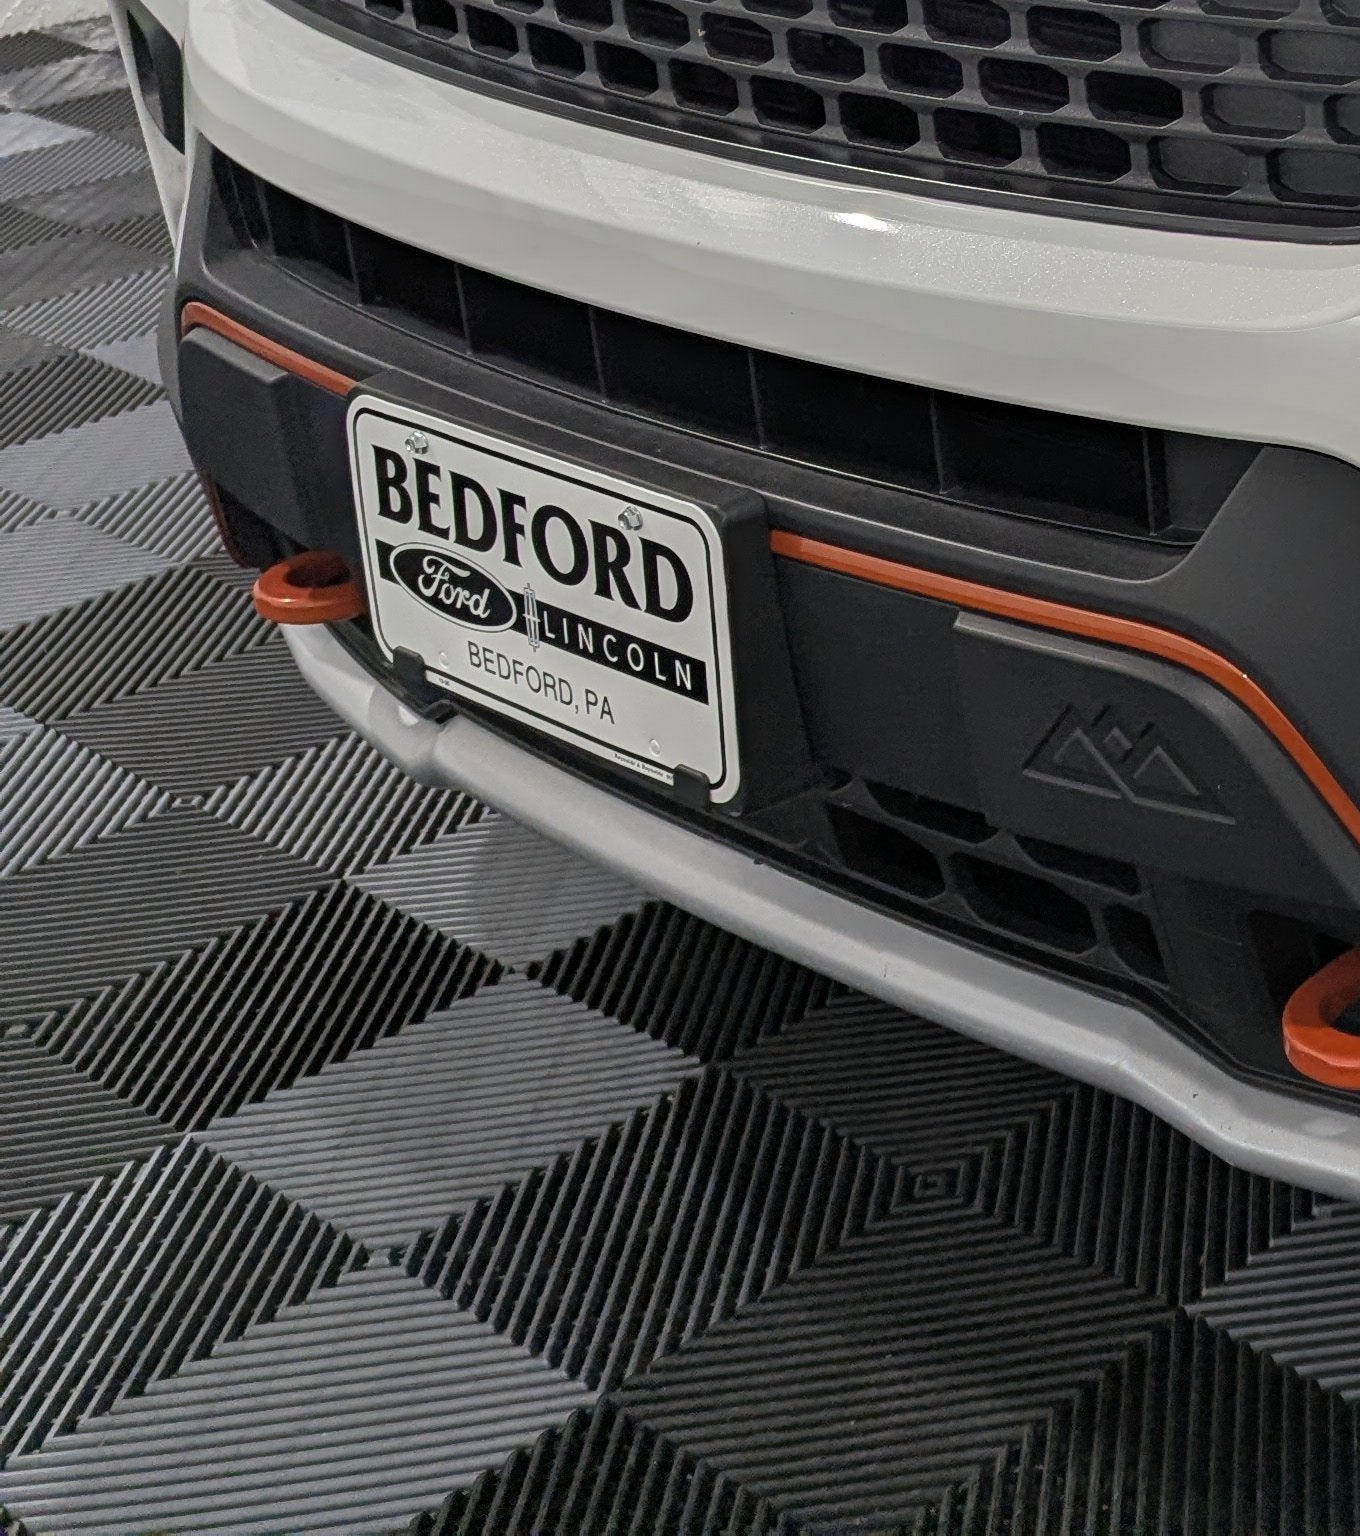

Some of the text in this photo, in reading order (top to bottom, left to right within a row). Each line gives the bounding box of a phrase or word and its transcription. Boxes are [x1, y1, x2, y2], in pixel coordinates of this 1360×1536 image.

[371, 444, 694, 624] BEDFORD
[416, 554, 490, 619] Ford
[467, 640, 616, 725] BEDFORD, PA
[543, 611, 692, 691] LINCOLN
